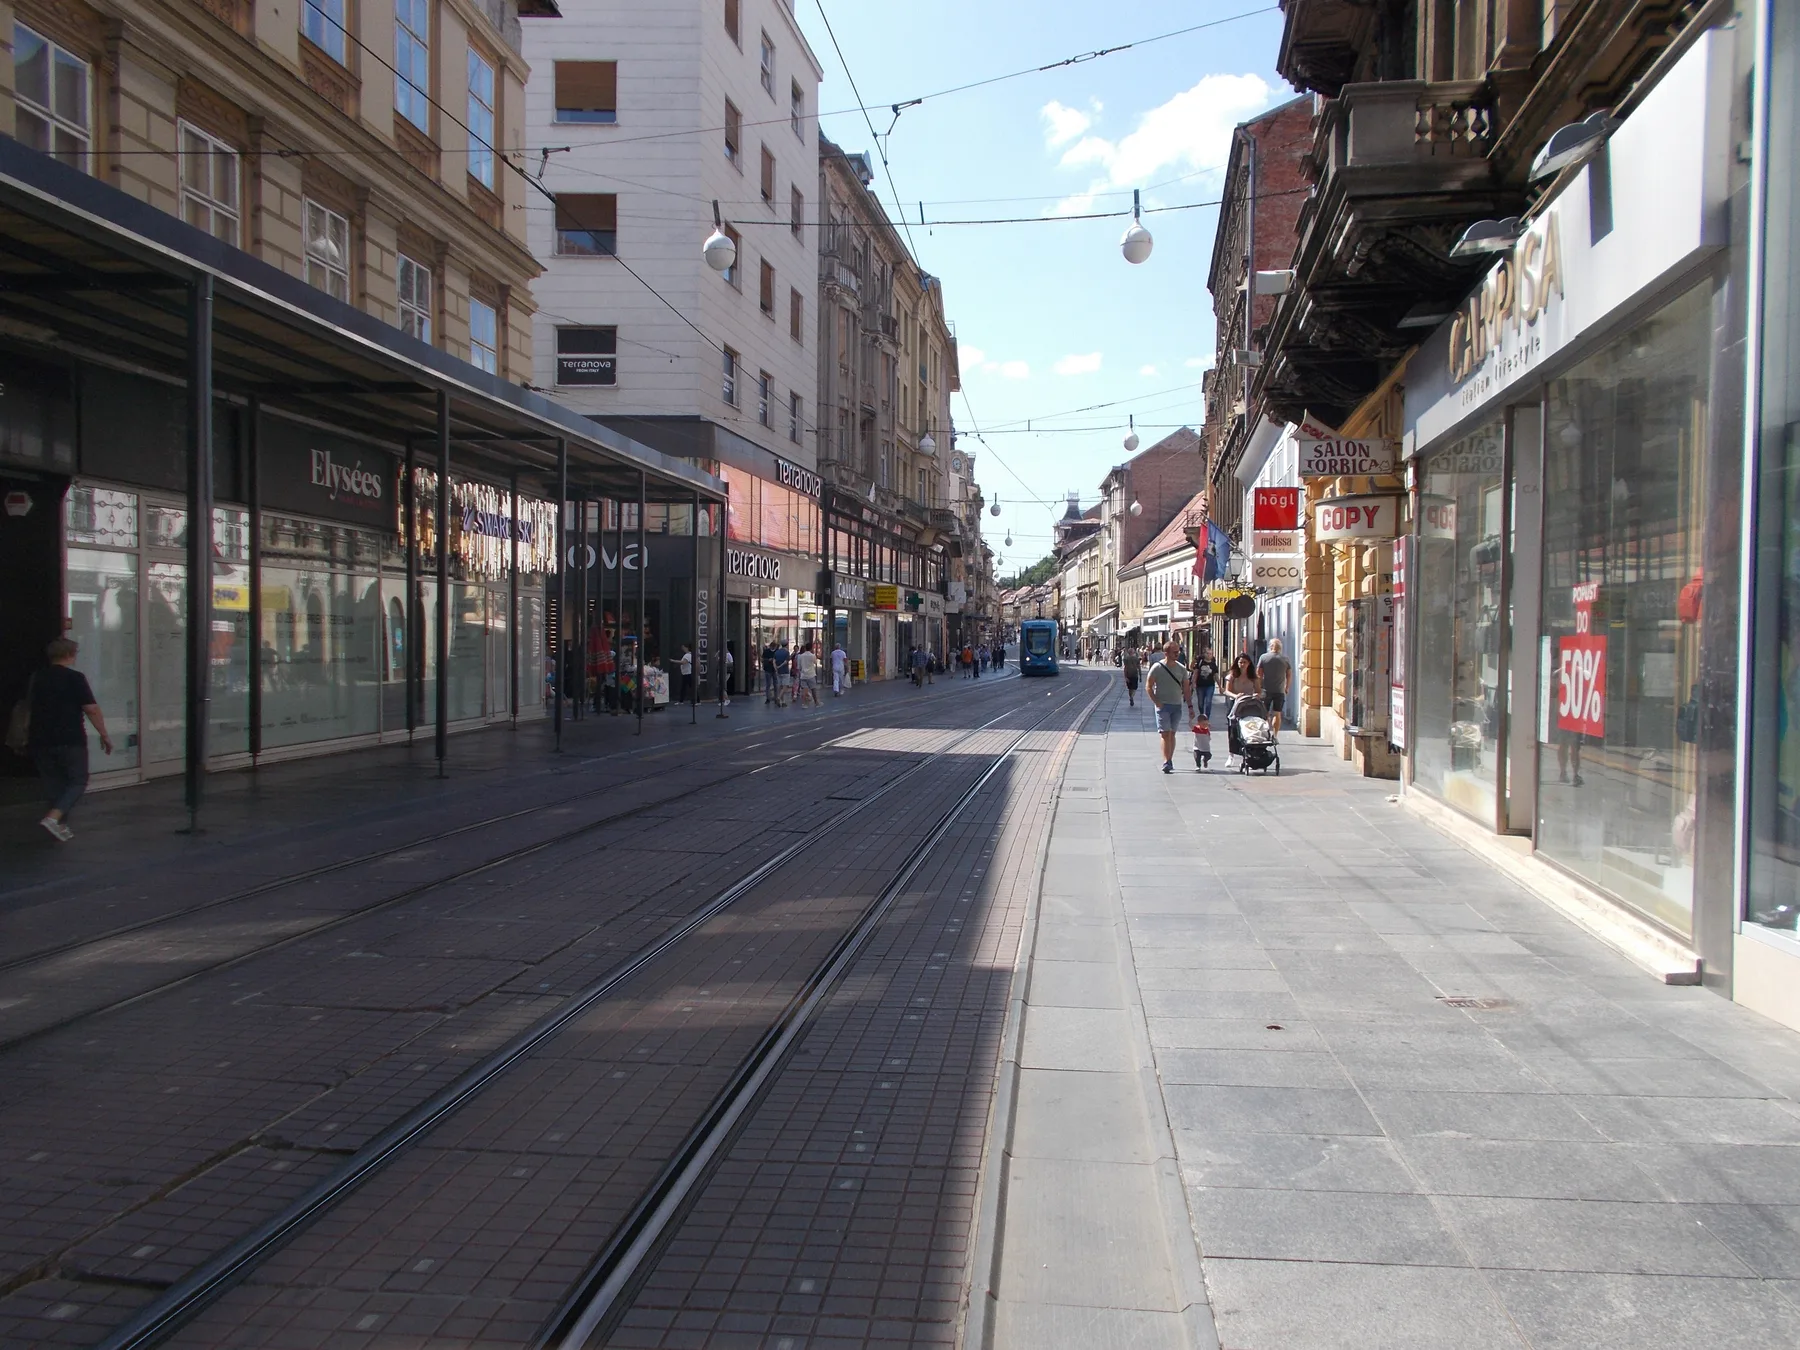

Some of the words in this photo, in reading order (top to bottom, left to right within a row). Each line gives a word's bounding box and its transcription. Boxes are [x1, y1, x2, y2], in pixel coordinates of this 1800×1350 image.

[1448, 209, 1564, 385] CARPISA
[1494, 335, 1541, 381] lifestyle
[1304, 457, 1380, 475] TORBICA
[1313, 440, 1371, 459] SALON
[310, 448, 382, 501] Elysées
[777, 458, 821, 498] Terranova
[476, 510, 534, 544] SWAROSKI
[1322, 505, 1380, 532] COPY
[1260, 535, 1292, 547] melissa
[727, 547, 781, 581] Terranova
[1256, 566, 1299, 578] ecco
[1572, 584, 1598, 604] POPUST
[698, 589, 709, 684] Terranova
[1576, 611, 1588, 634] DO
[1559, 649, 1602, 723] 50%
